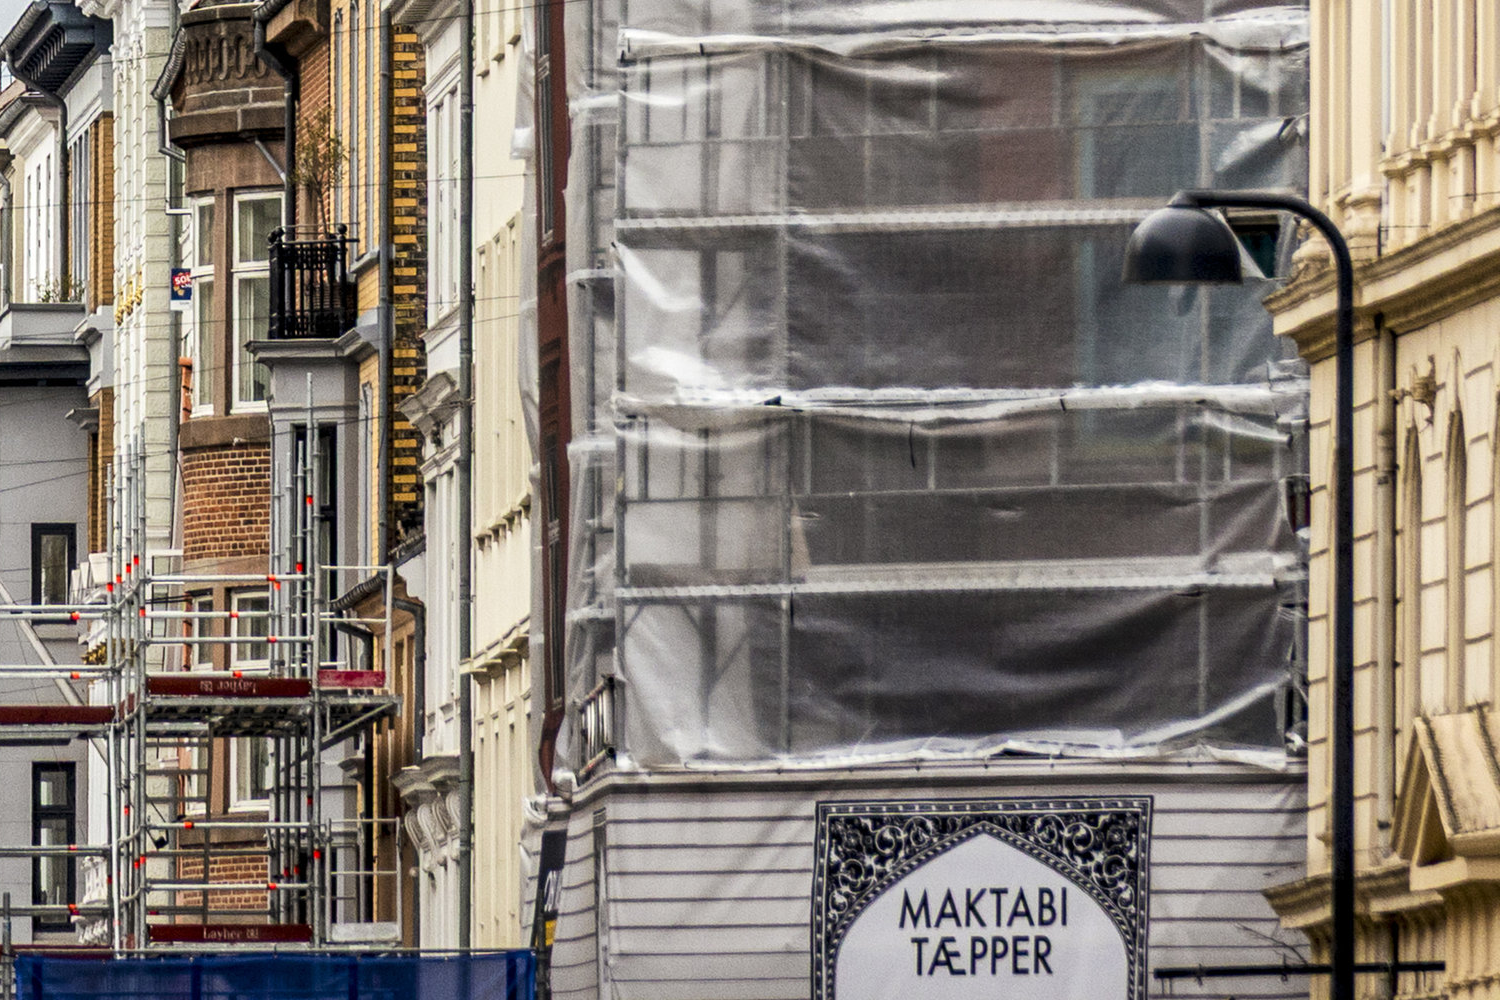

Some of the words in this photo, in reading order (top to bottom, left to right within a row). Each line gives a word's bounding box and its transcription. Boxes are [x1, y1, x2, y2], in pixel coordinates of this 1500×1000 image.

[899, 886, 1067, 929] MAKTABI
[203, 927, 241, 940] Layher
[911, 935, 1053, 976] TÆPPER
